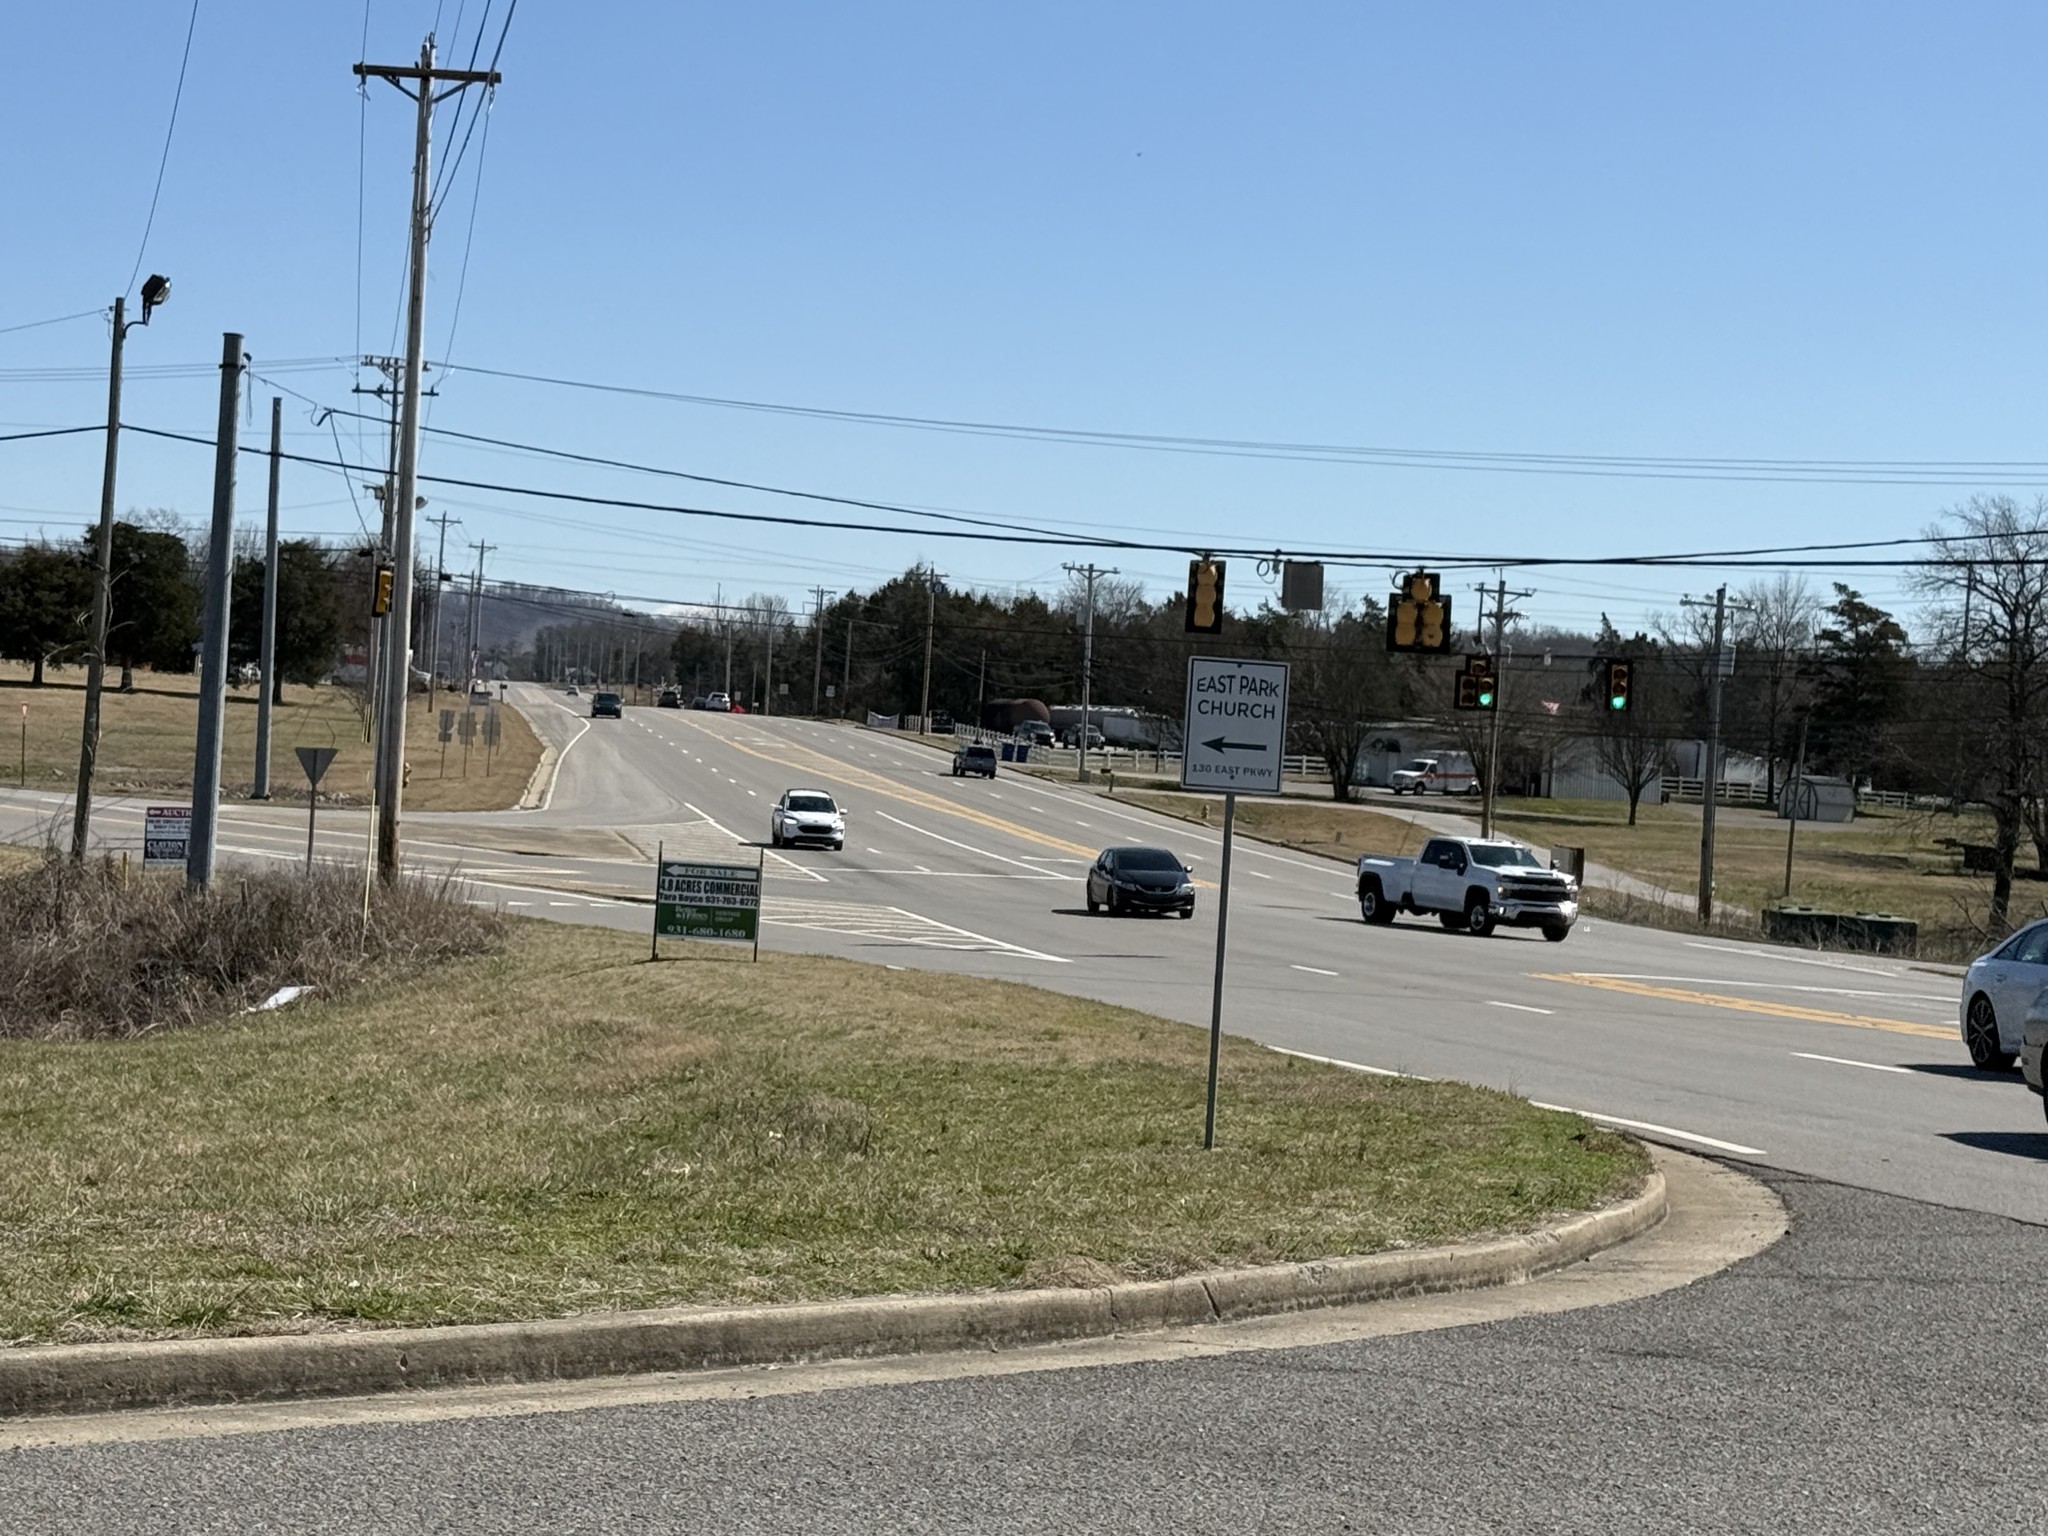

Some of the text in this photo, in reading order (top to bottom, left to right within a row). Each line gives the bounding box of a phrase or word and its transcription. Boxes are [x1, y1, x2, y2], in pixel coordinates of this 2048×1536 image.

[1197, 675, 1280, 697] EAST PARK
[1198, 699, 1275, 720] CHURCH
[1192, 764, 1273, 777] 130 EAST PKWY
[710, 869, 738, 877] SALE
[674, 879, 702, 893] ACRES
[704, 881, 759, 897] COMMERCIAL
[667, 925, 746, 938] 931-680-1680
